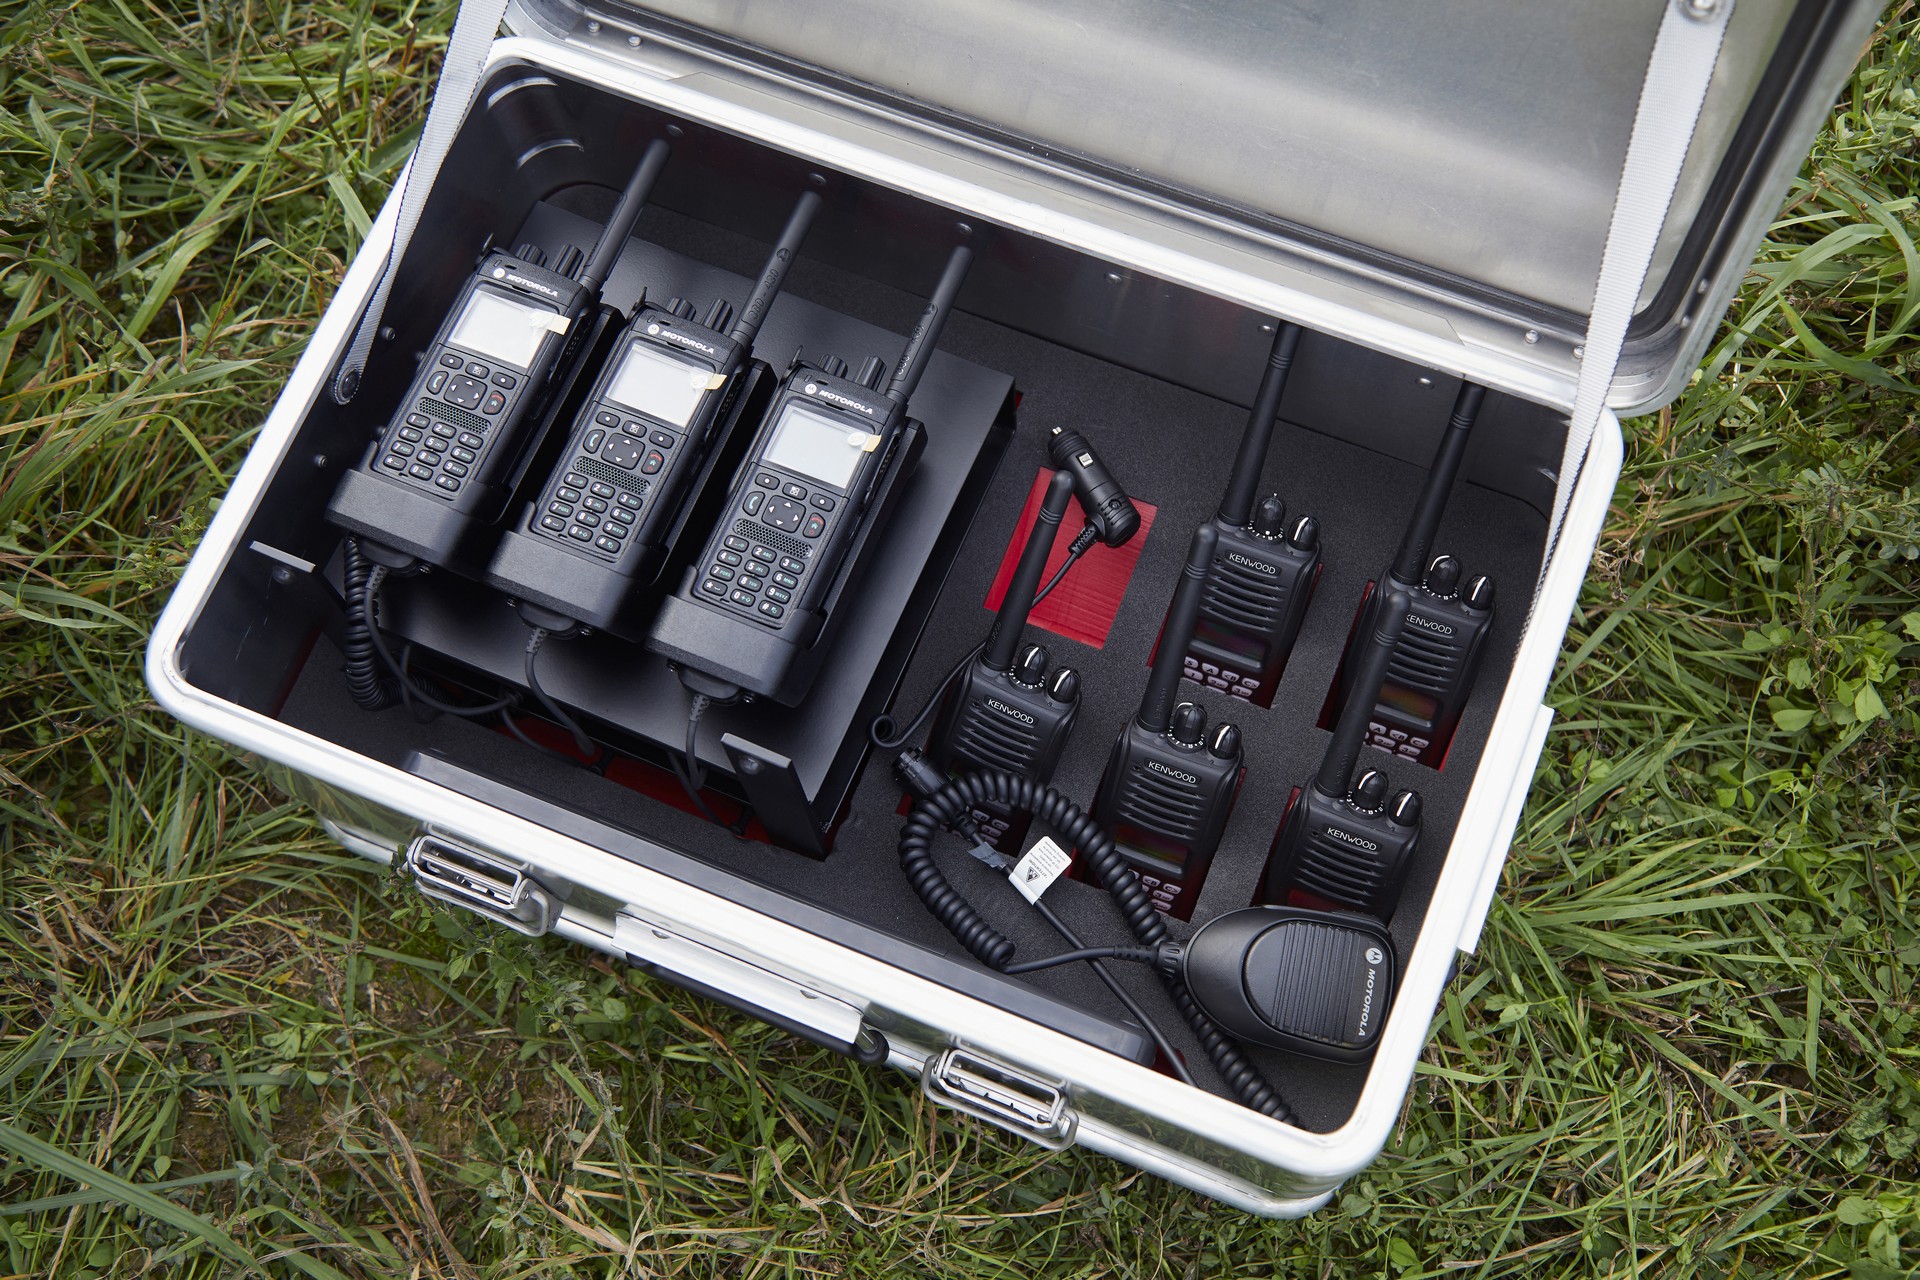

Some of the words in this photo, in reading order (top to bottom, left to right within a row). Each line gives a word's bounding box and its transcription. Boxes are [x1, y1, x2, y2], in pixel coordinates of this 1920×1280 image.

[507, 274, 558, 297] MOTOROLA
[662, 331, 714, 354] MOTOROLA
[819, 390, 873, 414] MOTOROLA
[1229, 553, 1276, 574] KENWOOD
[988, 699, 1034, 724] KENWOOD
[1148, 761, 1196, 784] KENWOOD
[1327, 828, 1377, 850] KENWOOD
[1358, 968, 1376, 1036] MOTOROLA
